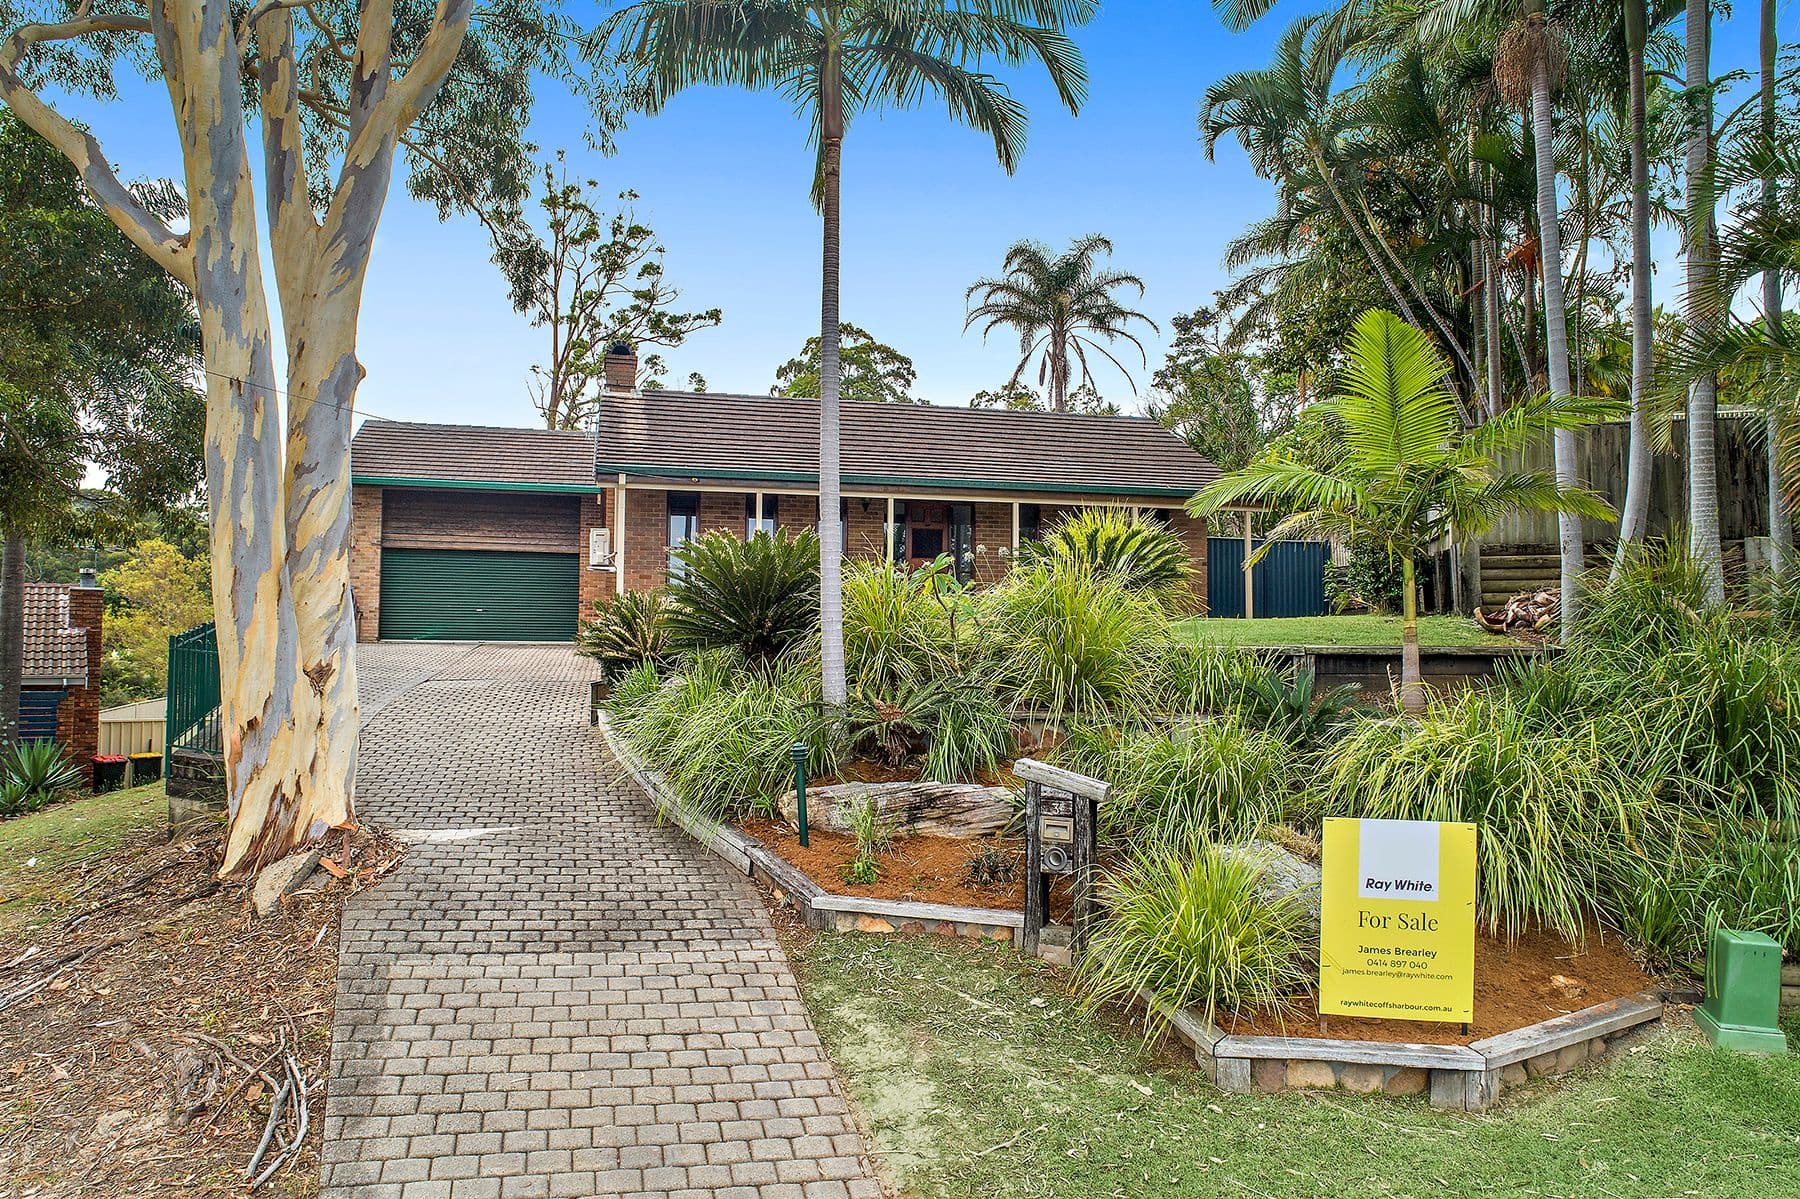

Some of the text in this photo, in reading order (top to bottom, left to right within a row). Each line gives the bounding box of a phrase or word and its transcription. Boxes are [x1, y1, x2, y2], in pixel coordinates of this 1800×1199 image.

[1365, 878, 1392, 892] Ray
[1358, 910, 1439, 932] For Sale
[1358, 945, 1438, 959] James Brearley
[1366, 958, 1428, 970] 0414 897 040
[1342, 967, 1453, 981] james.brearley@raywhite.com
[1340, 999, 1453, 1013] raywhitecoffsharbour.com.au
